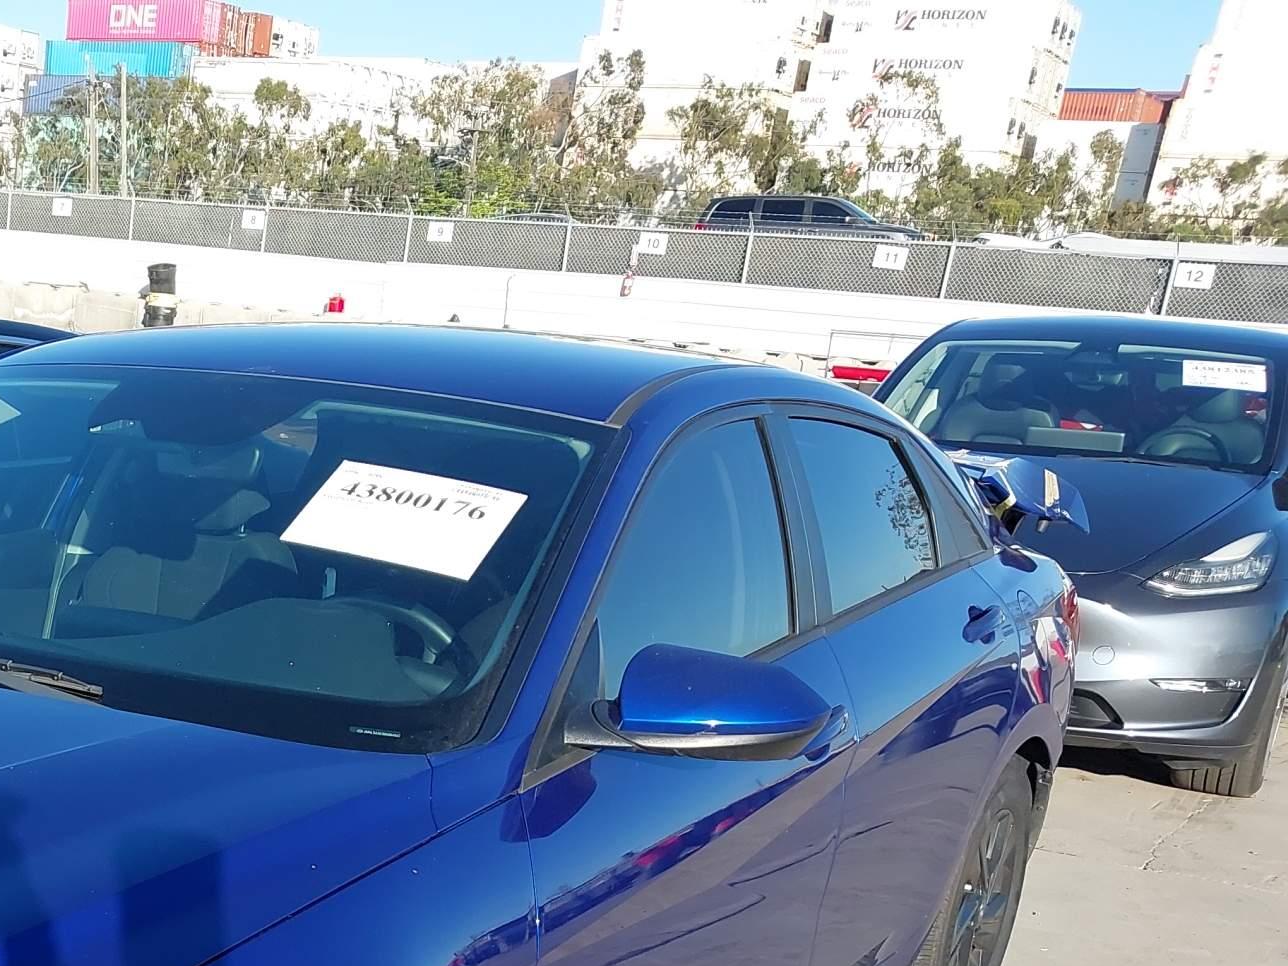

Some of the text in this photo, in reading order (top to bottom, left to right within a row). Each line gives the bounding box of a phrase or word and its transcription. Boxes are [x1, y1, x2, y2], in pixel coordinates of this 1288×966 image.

[109, 4, 157, 28] ONE
[921, 9, 988, 22] HORIZON
[899, 57, 965, 71] HORIZON
[877, 107, 942, 121] HORIZON
[250, 215, 256, 225] 8
[437, 226, 444, 237] 9
[647, 238, 660, 249] 10
[885, 252, 898, 264] 11
[1186, 270, 1205, 282] 12
[340, 481, 487, 521] 43800176
